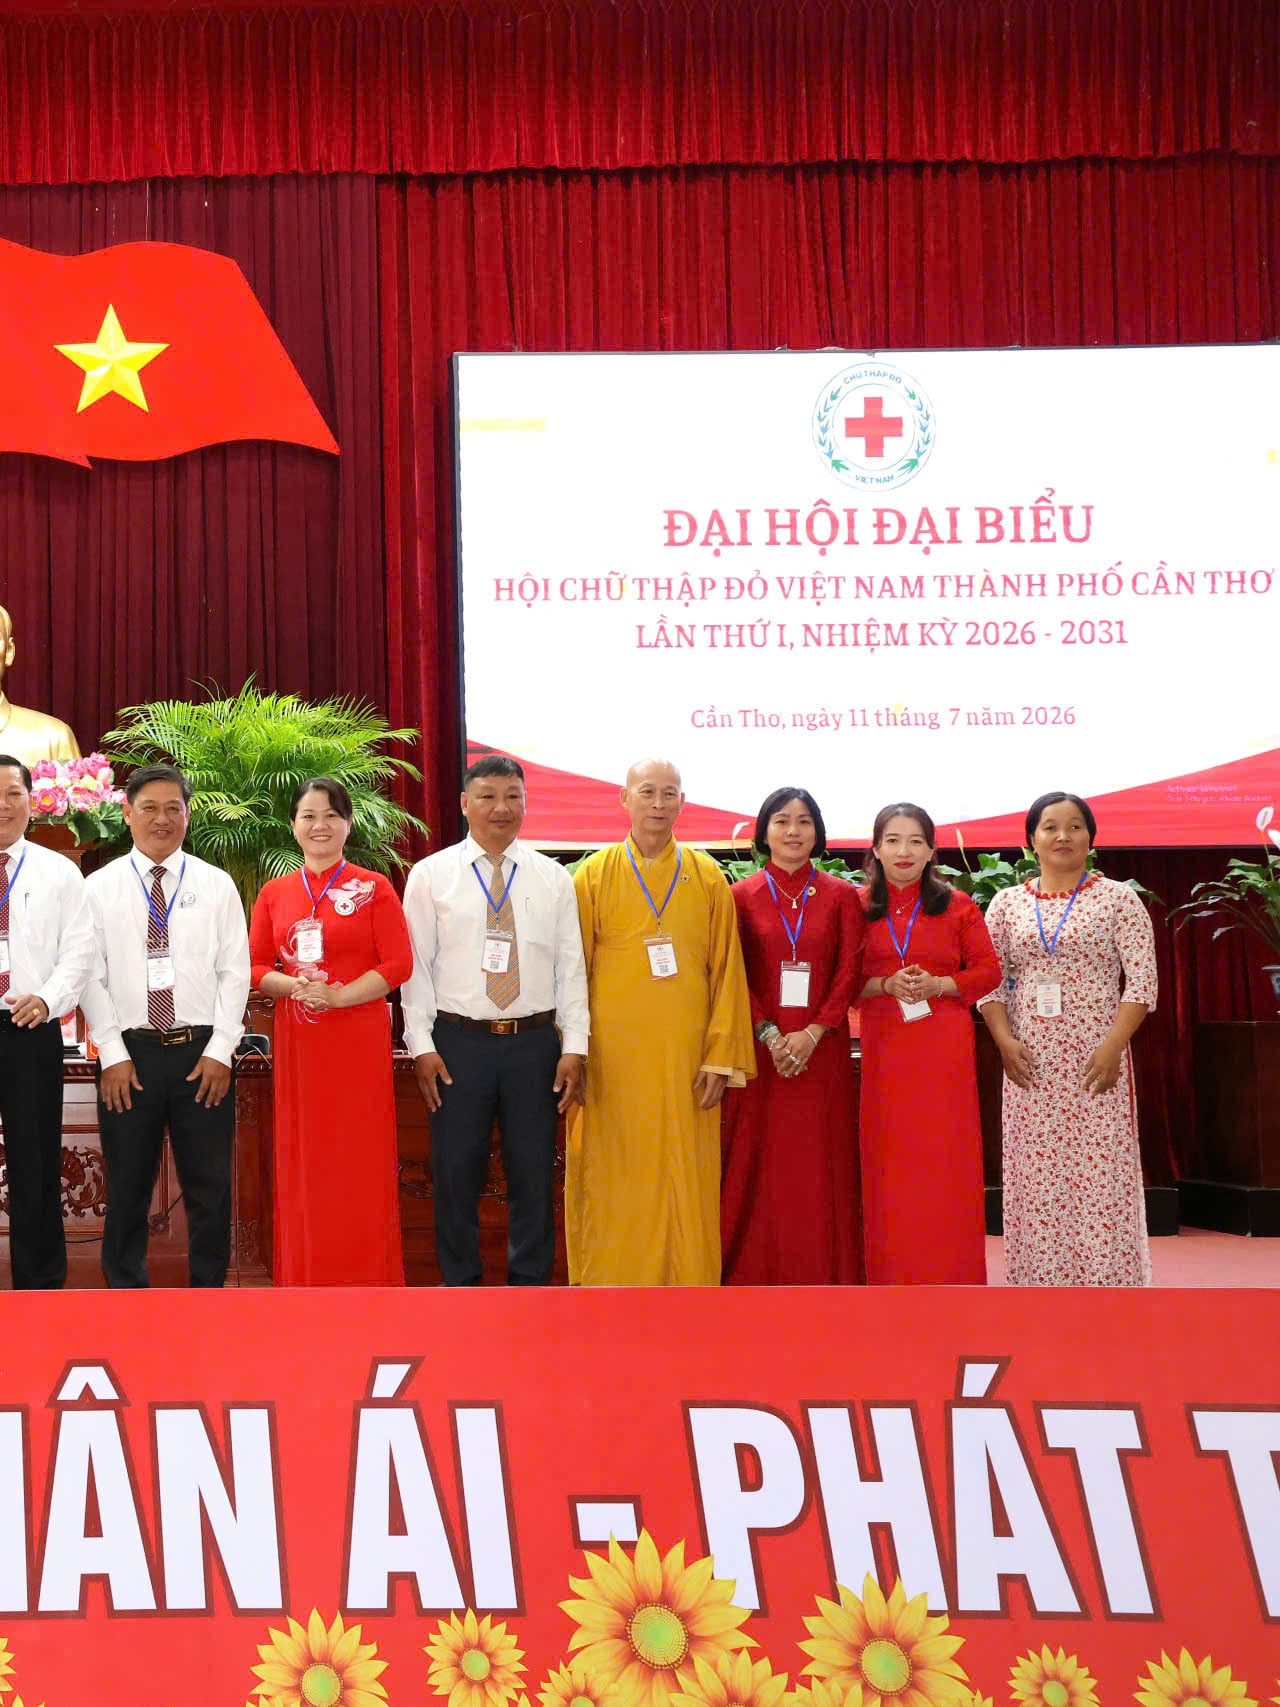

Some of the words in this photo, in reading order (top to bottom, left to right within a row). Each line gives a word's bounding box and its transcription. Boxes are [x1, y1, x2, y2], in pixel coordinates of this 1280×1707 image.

[663, 508, 752, 558] ĐẠI
[764, 497, 860, 557] HỘI
[872, 505, 963, 556] ĐẠI
[974, 487, 1095, 544] BIỂU
[492, 571, 551, 609] HỘI
[559, 570, 628, 601] CHỮ
[632, 571, 717, 608] THẬP
[723, 569, 769, 600] ĐỎ
[776, 570, 846, 606] VIỆT
[853, 574, 924, 599] NAM
[933, 568, 1048, 599] THÀNH
[1056, 560, 1124, 597] PHỐ
[1131, 560, 1196, 596] CẦN
[1203, 567, 1276, 595] THƠ
[634, 614, 696, 649] LẦN
[703, 617, 772, 649] THỨ
[776, 623, 795, 652] I,
[801, 616, 910, 654] NHIỆM
[917, 616, 959, 647] KỲ
[964, 620, 1037, 647] 2026
[1060, 619, 1129, 645] 2031
[690, 704, 733, 729] Cần
[738, 707, 786, 730] Thơ,
[791, 708, 844, 731] ngày
[849, 709, 870, 727] 11
[874, 707, 941, 730] tháng
[949, 707, 960, 726] 7
[965, 708, 1015, 727] năm
[1021, 706, 1076, 727] 2026
[343, 1360, 521, 1614] ÁI
[684, 1360, 1160, 1617] PHÁT
[1189, 1408, 1280, 1618] T
